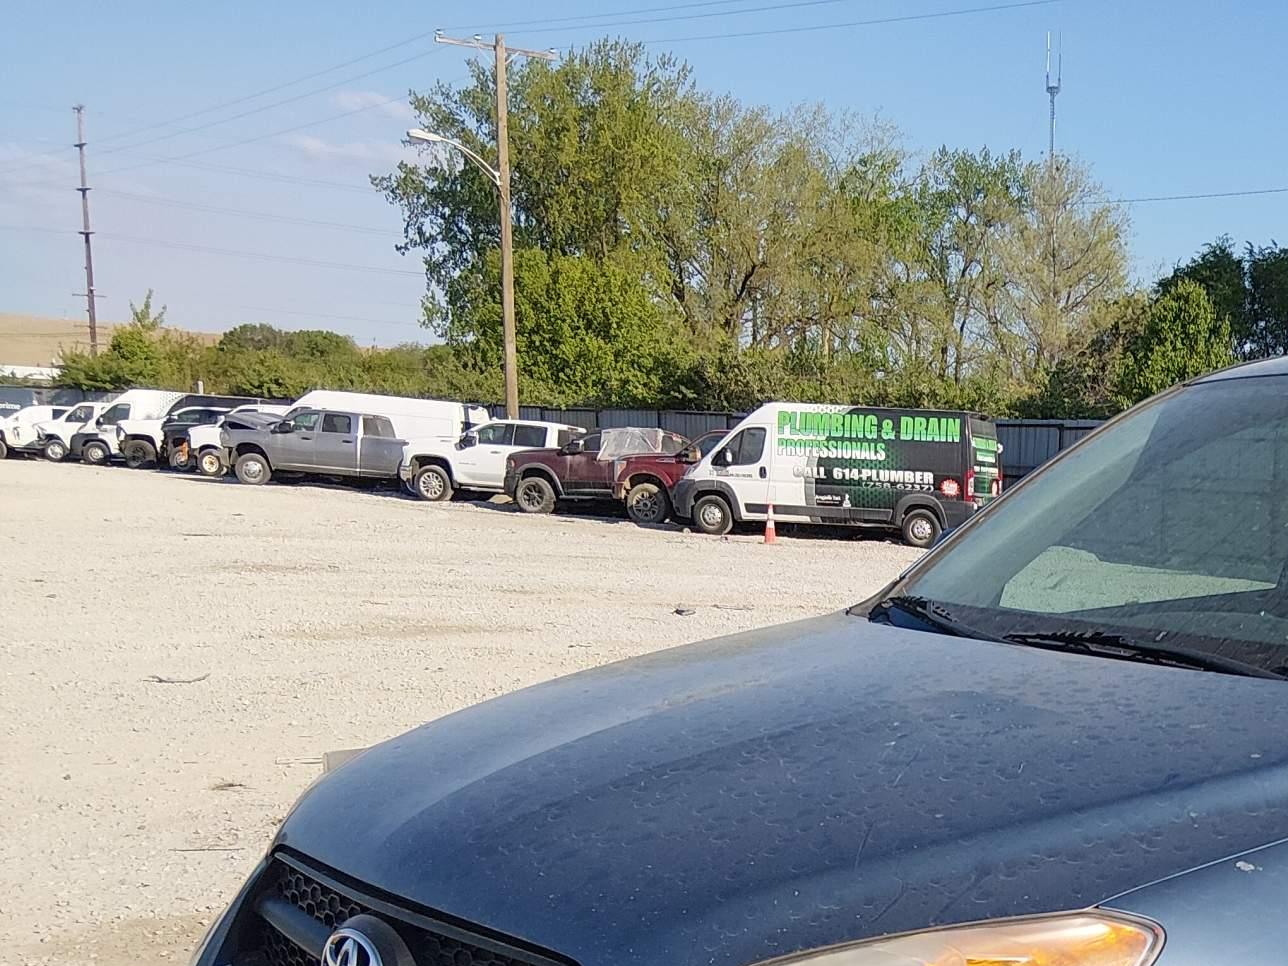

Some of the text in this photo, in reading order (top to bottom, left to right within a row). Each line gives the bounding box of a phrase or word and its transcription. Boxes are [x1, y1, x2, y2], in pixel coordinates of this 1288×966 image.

[777, 410, 961, 443] PLUMBING & DRAIN
[777, 438, 886, 461] PROFESSIONALS
[792, 465, 934, 485] CALL 614-PLUMBER
